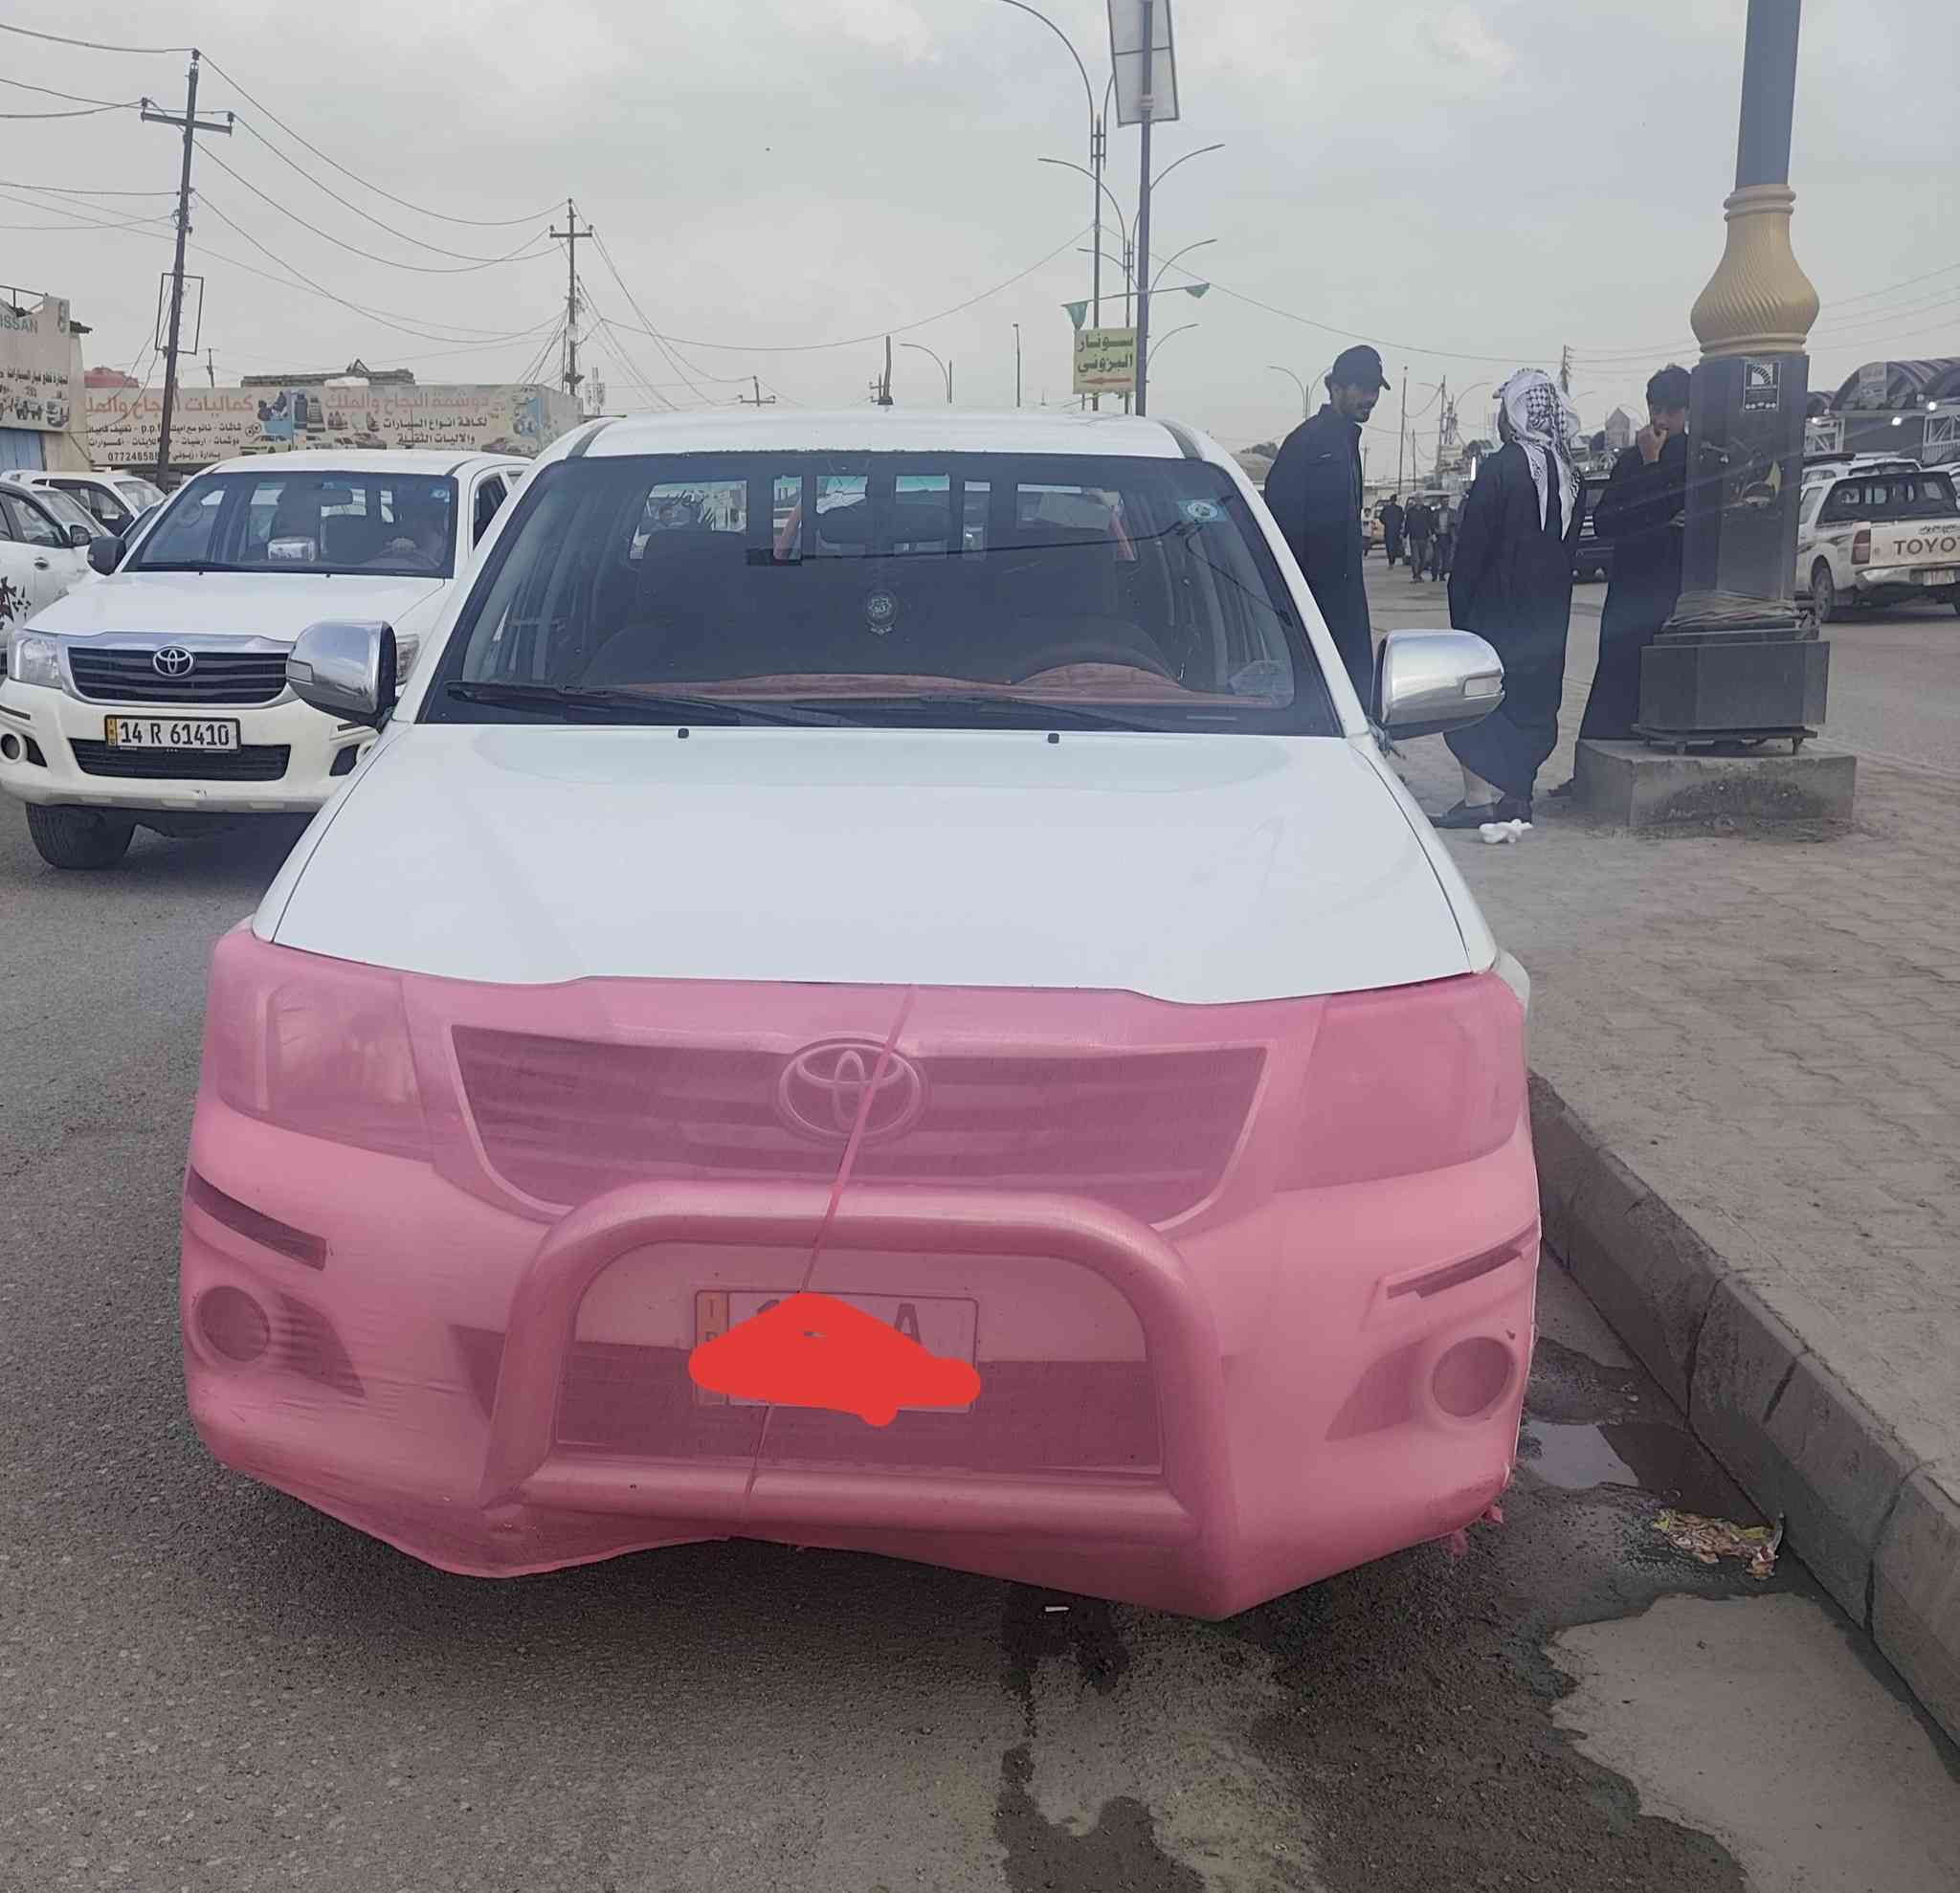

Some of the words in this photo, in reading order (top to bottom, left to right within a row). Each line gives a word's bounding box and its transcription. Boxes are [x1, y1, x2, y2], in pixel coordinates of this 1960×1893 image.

[185, 394, 254, 417] كماليات
[121, 722, 143, 744] 14
[150, 723, 162, 745] R
[170, 724, 229, 746] 61410
